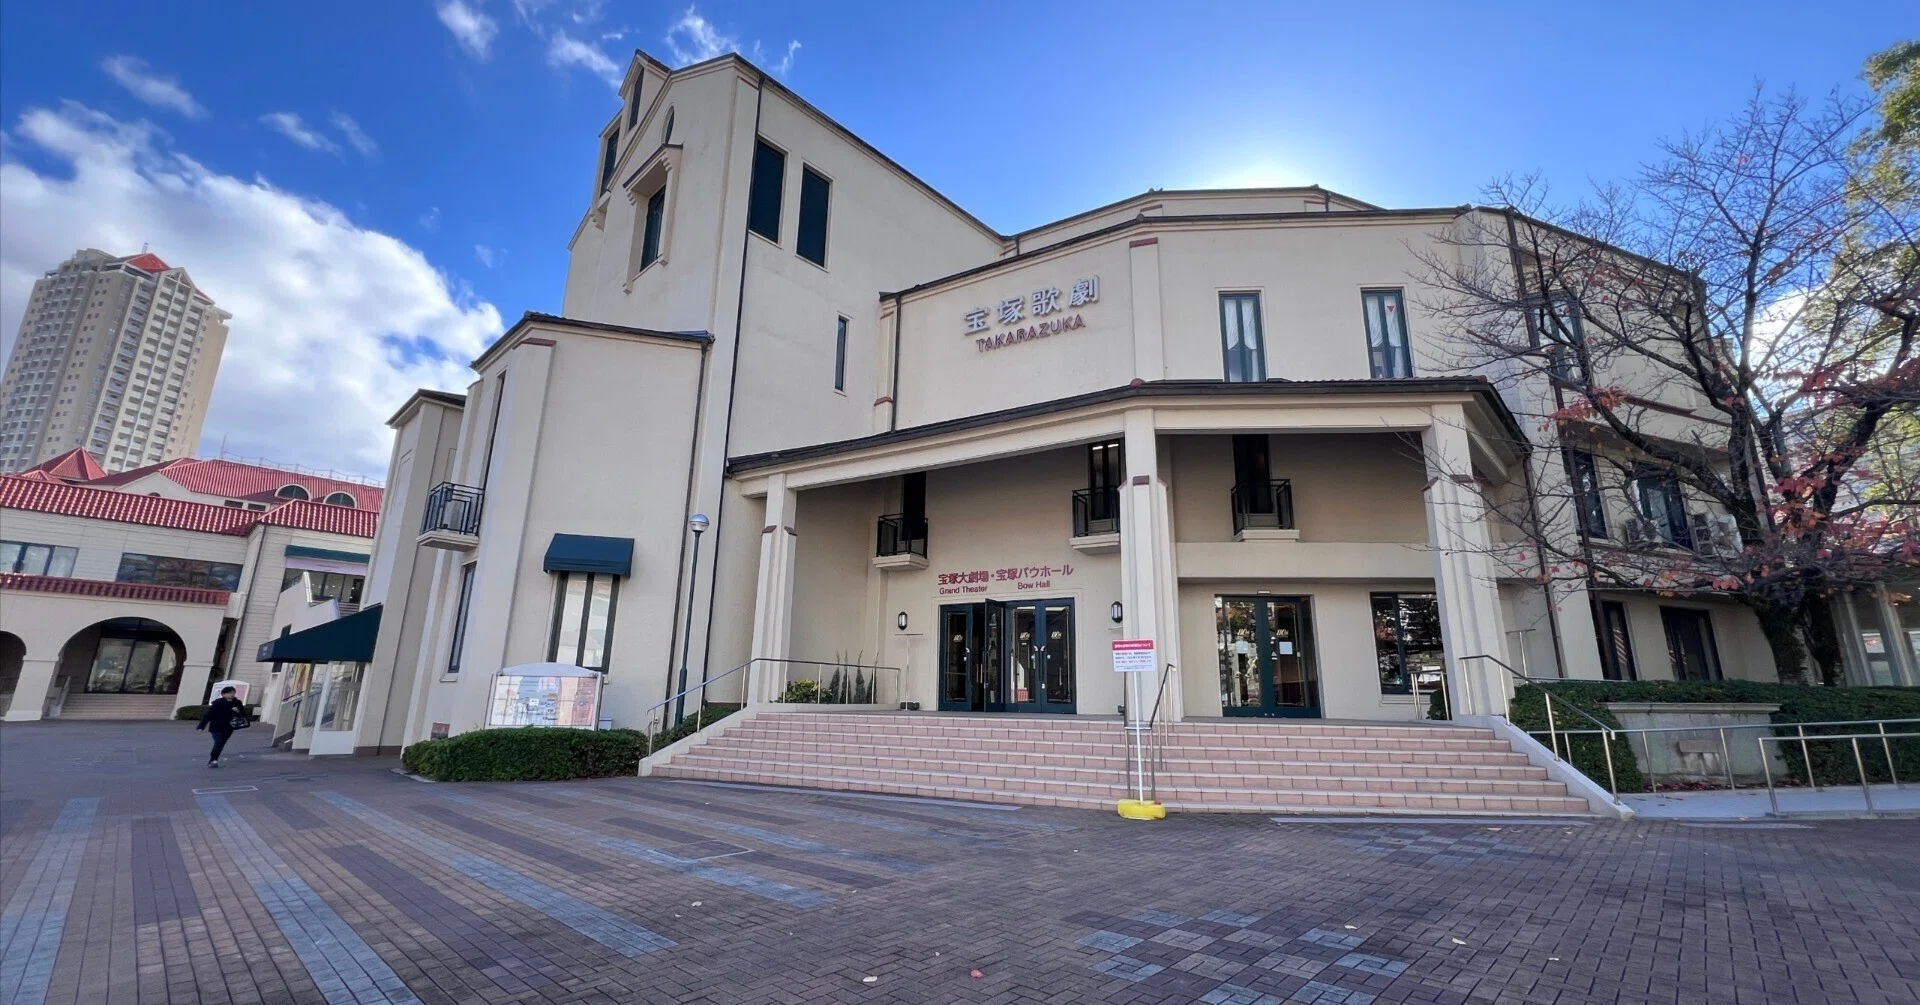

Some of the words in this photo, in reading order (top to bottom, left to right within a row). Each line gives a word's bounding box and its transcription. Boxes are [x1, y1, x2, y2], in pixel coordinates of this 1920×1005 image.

[963, 274, 1100, 336] 宝塚歌劇
[975, 313, 1086, 352] TAKARAZUKA
[939, 586, 960, 595] Grand
[961, 585, 988, 594] Theater
[1017, 581, 1034, 590] Bow
[1035, 580, 1051, 589] Hall
